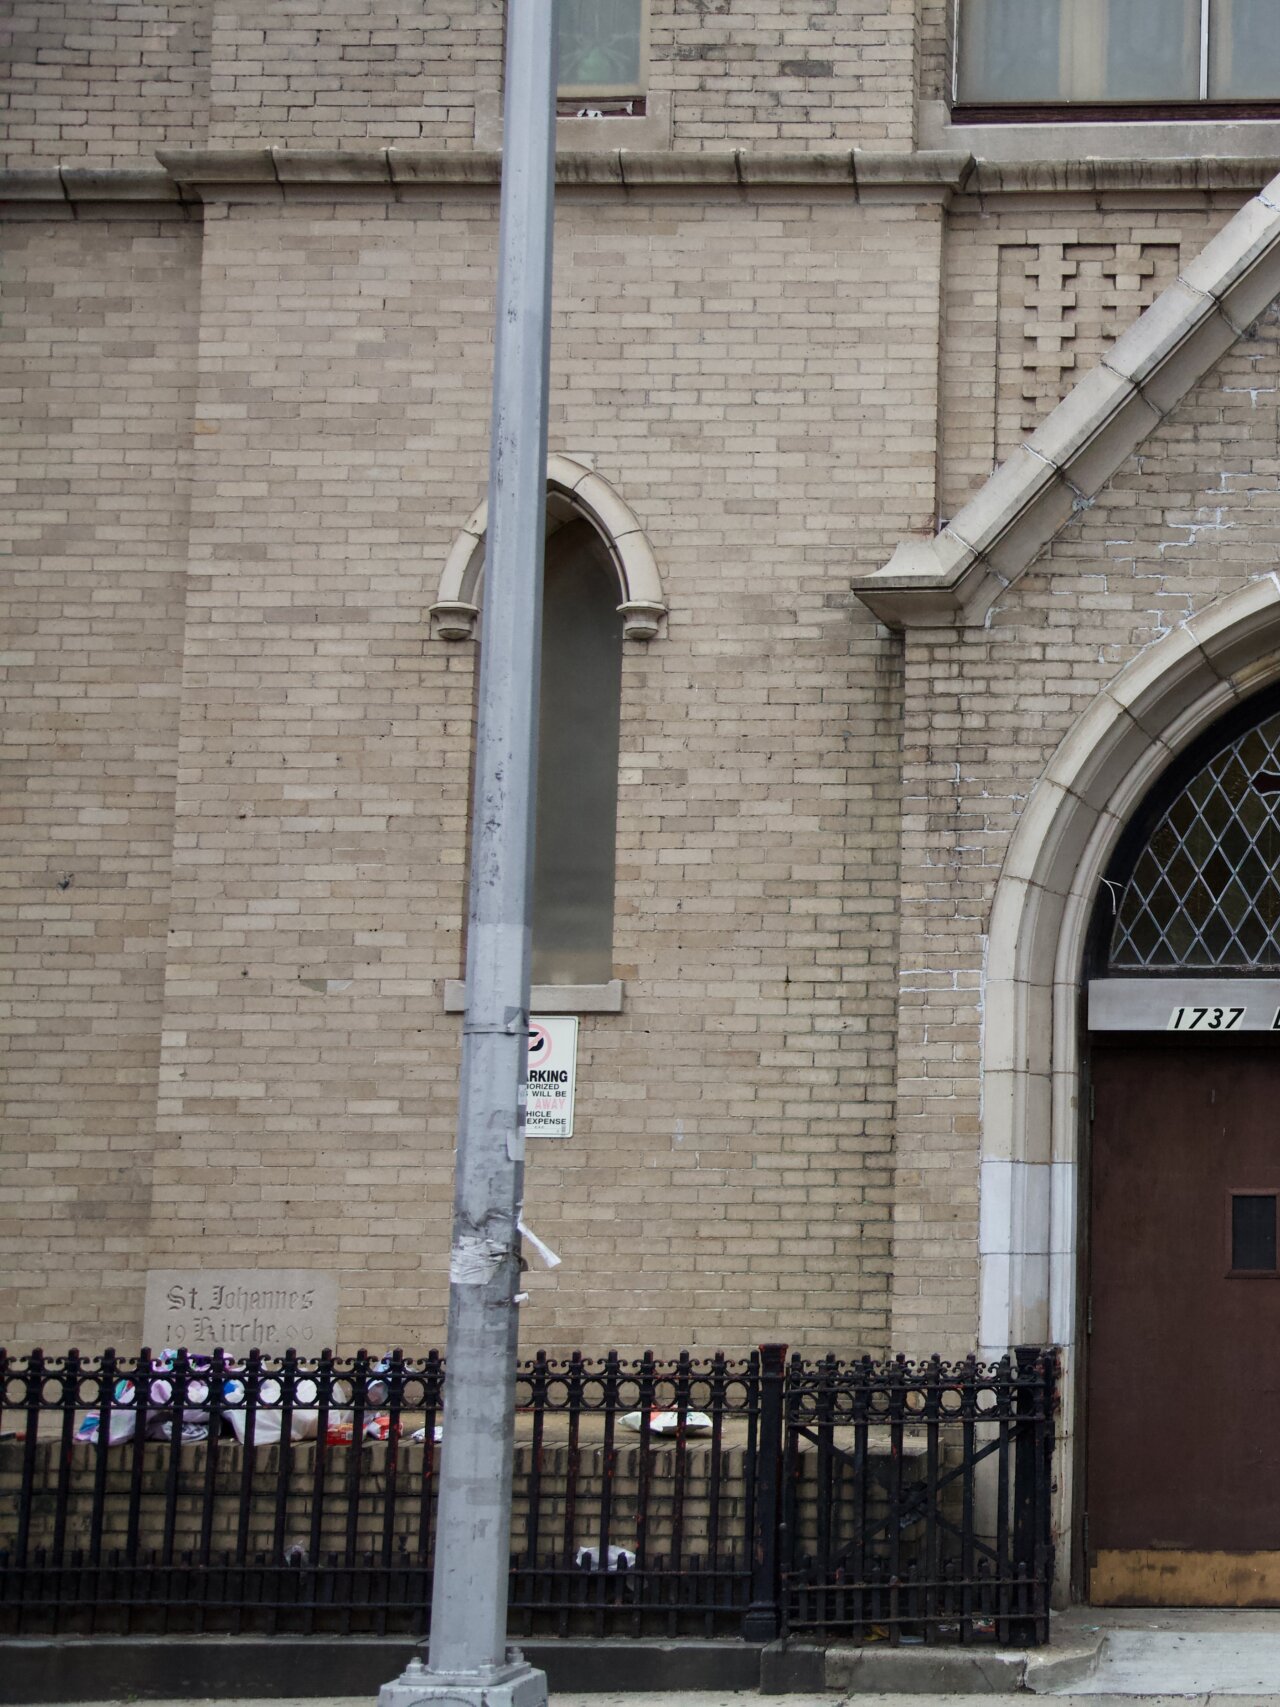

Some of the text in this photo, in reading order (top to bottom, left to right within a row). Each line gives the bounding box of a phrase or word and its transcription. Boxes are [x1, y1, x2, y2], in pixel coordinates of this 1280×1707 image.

[1173, 1008, 1245, 1029] 1737
[527, 1070, 568, 1082] RKING
[535, 1099, 566, 1109] AWAY
[167, 1285, 315, 1315] St. Johannes
[166, 1325, 186, 1342] 19
